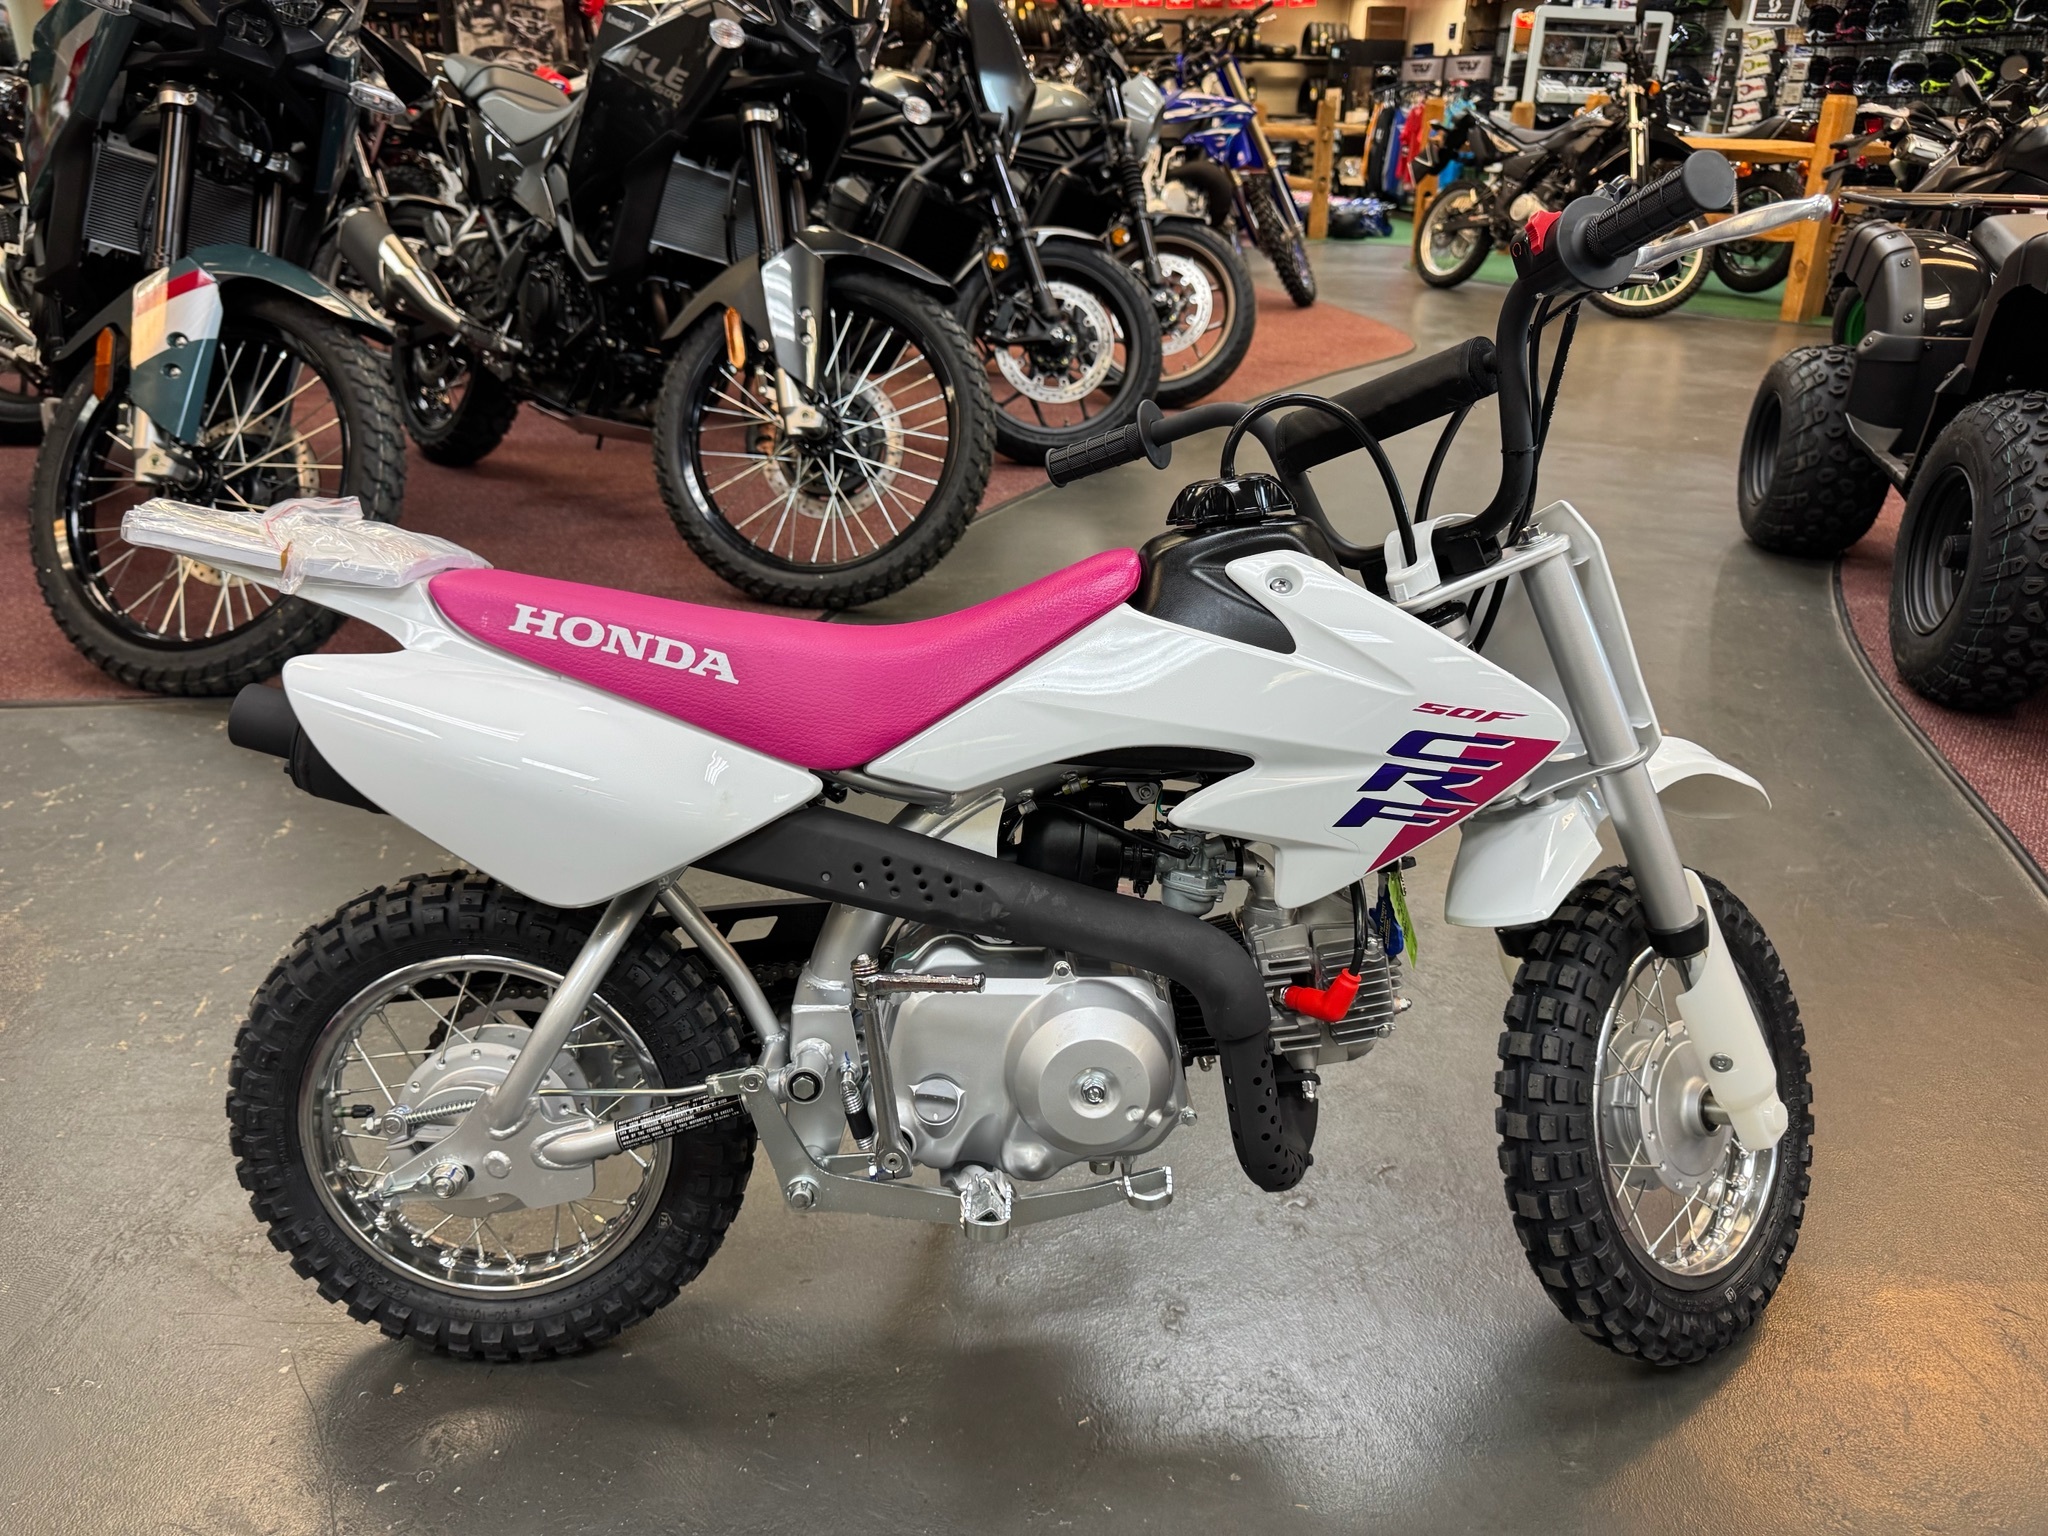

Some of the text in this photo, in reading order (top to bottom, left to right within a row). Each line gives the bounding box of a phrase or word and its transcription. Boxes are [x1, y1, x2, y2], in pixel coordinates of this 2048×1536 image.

[627, 46, 690, 92] KLE
[508, 604, 739, 685] HONDA
[1412, 702, 1530, 723] 50F
[1332, 730, 1516, 828] CRF
